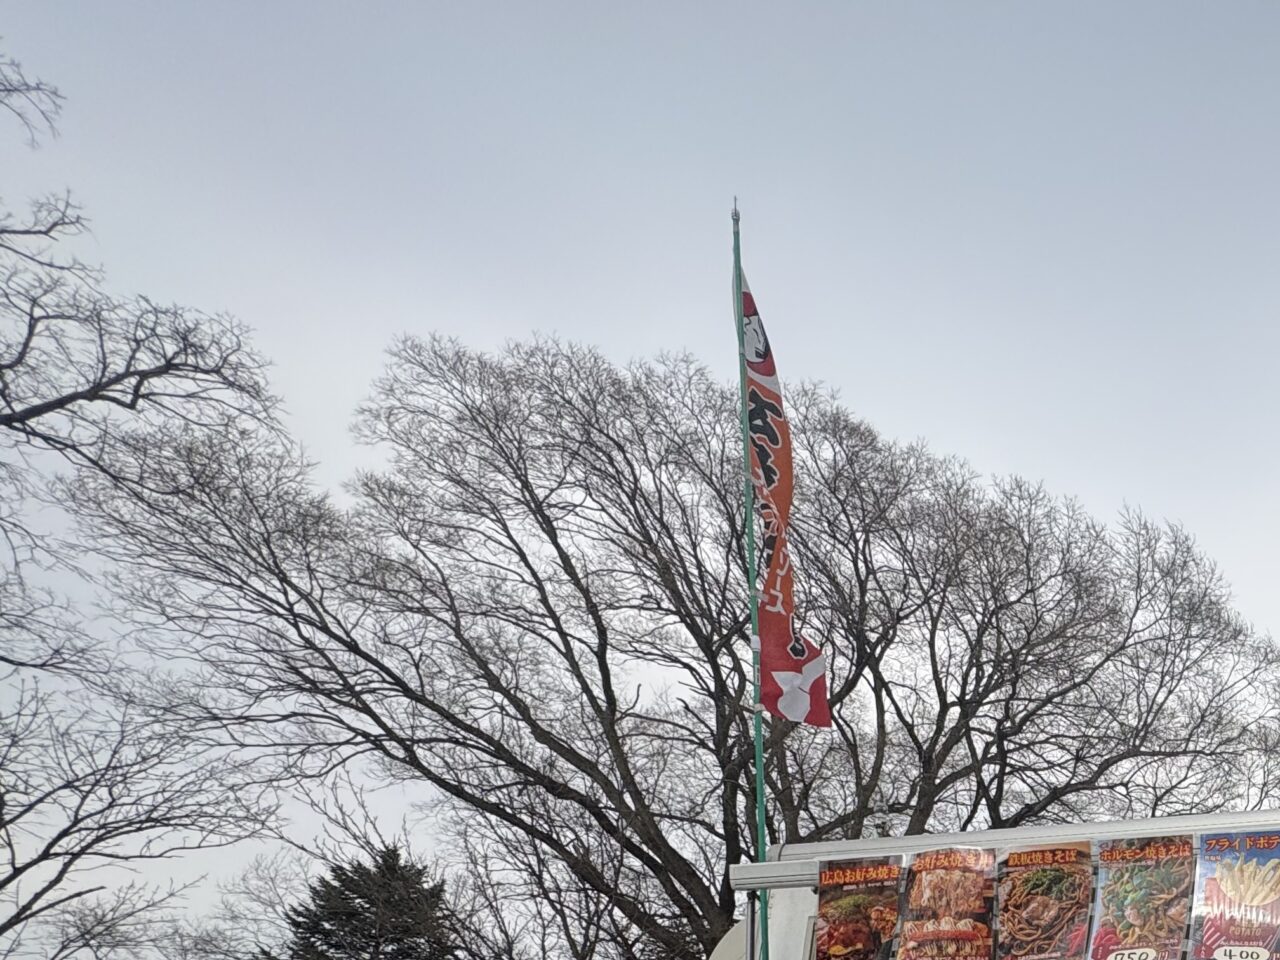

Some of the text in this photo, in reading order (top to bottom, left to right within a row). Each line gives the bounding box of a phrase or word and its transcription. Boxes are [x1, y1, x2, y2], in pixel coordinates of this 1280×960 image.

[1008, 849, 1077, 866] 鉄板焼きそば
[1100, 844, 1192, 861] ホルモン焼きそば
[822, 865, 901, 885] 広島お好み焼き
[1223, 949, 1260, 960] 400
